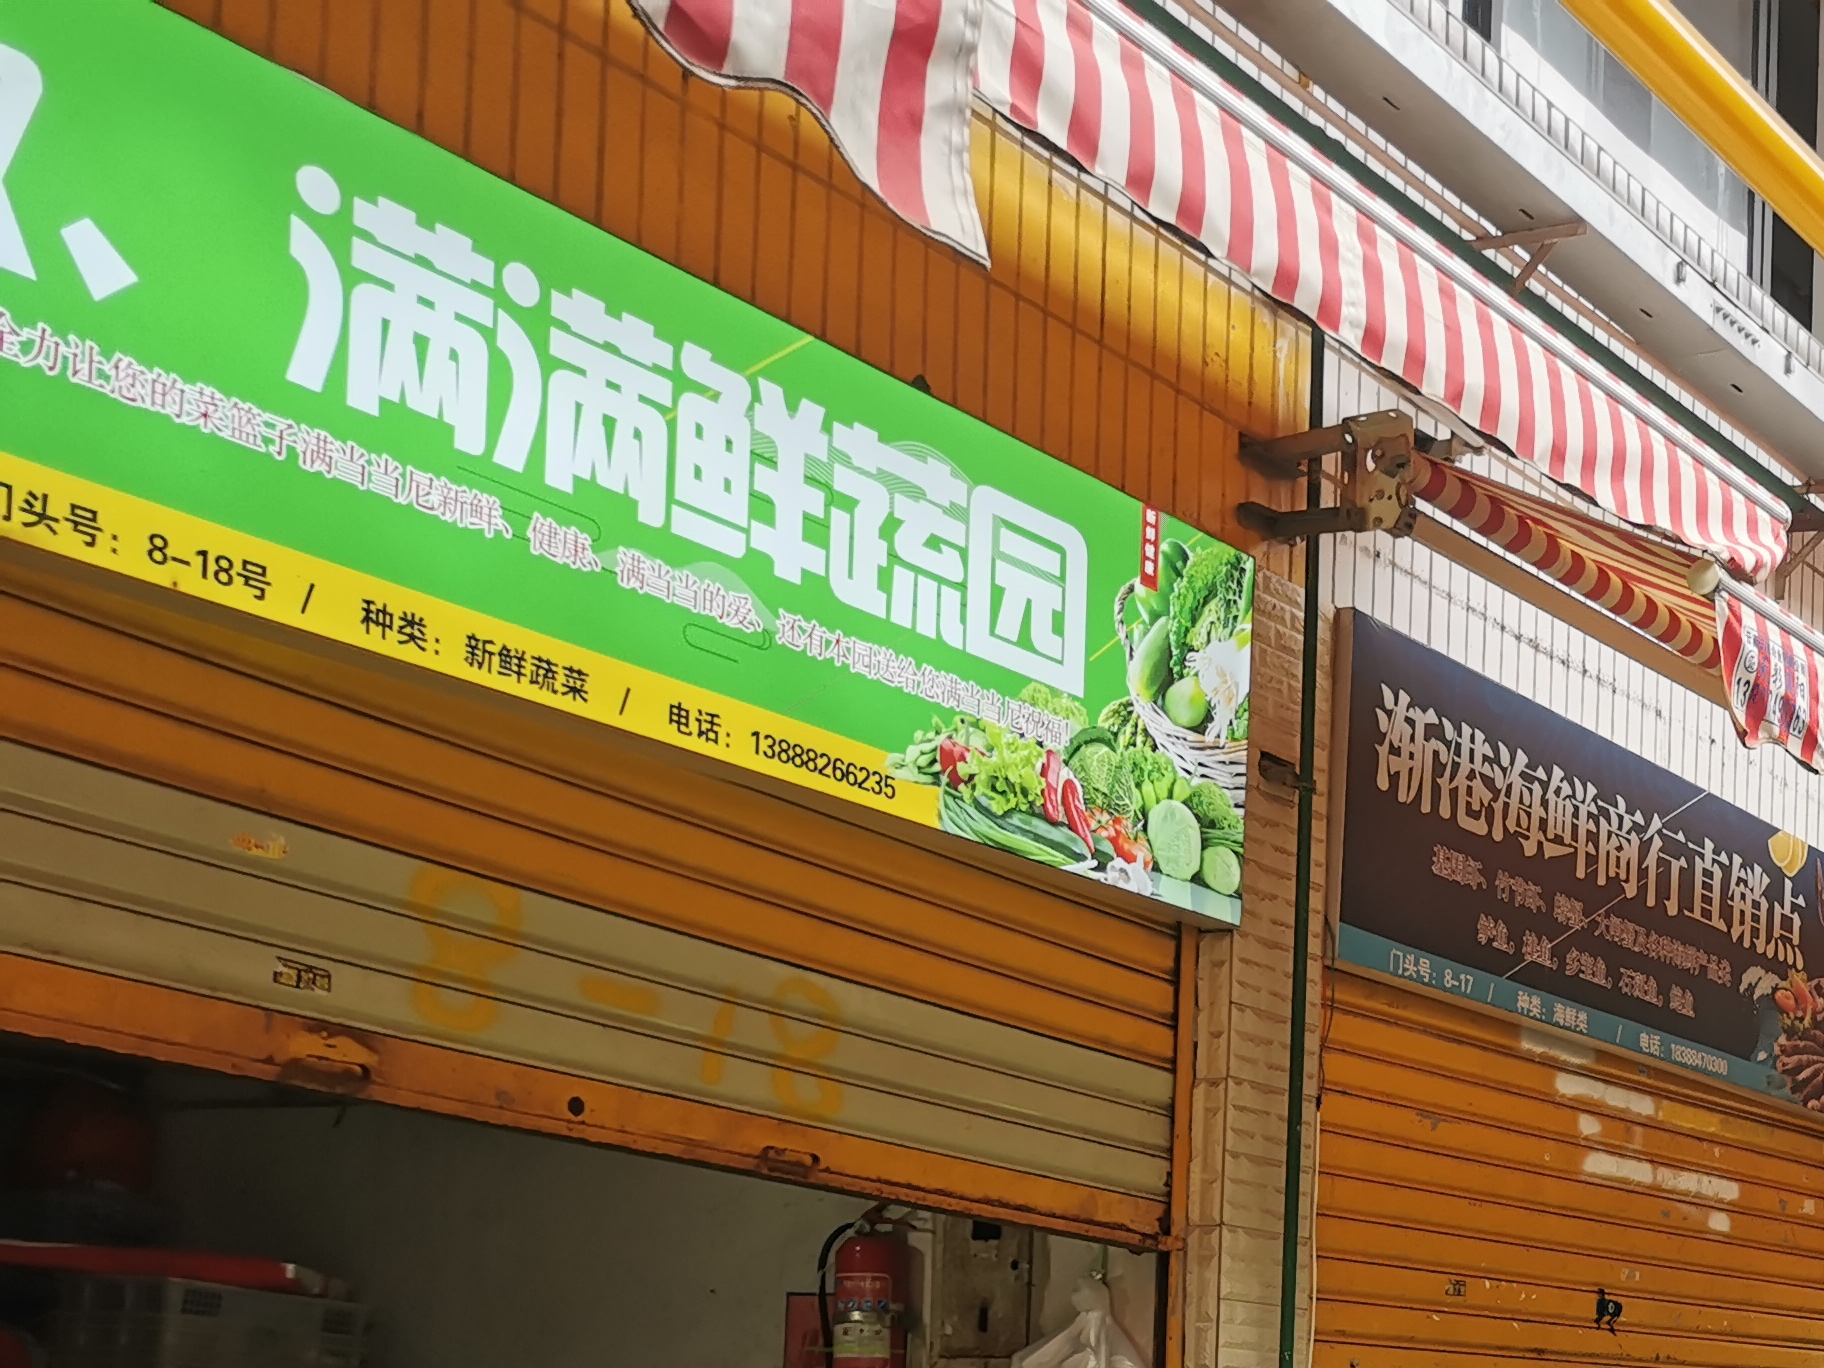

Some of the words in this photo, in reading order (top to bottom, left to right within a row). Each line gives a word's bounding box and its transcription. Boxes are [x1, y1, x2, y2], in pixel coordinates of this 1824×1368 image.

[284, 164, 1088, 698] 满满鲜蔬园
